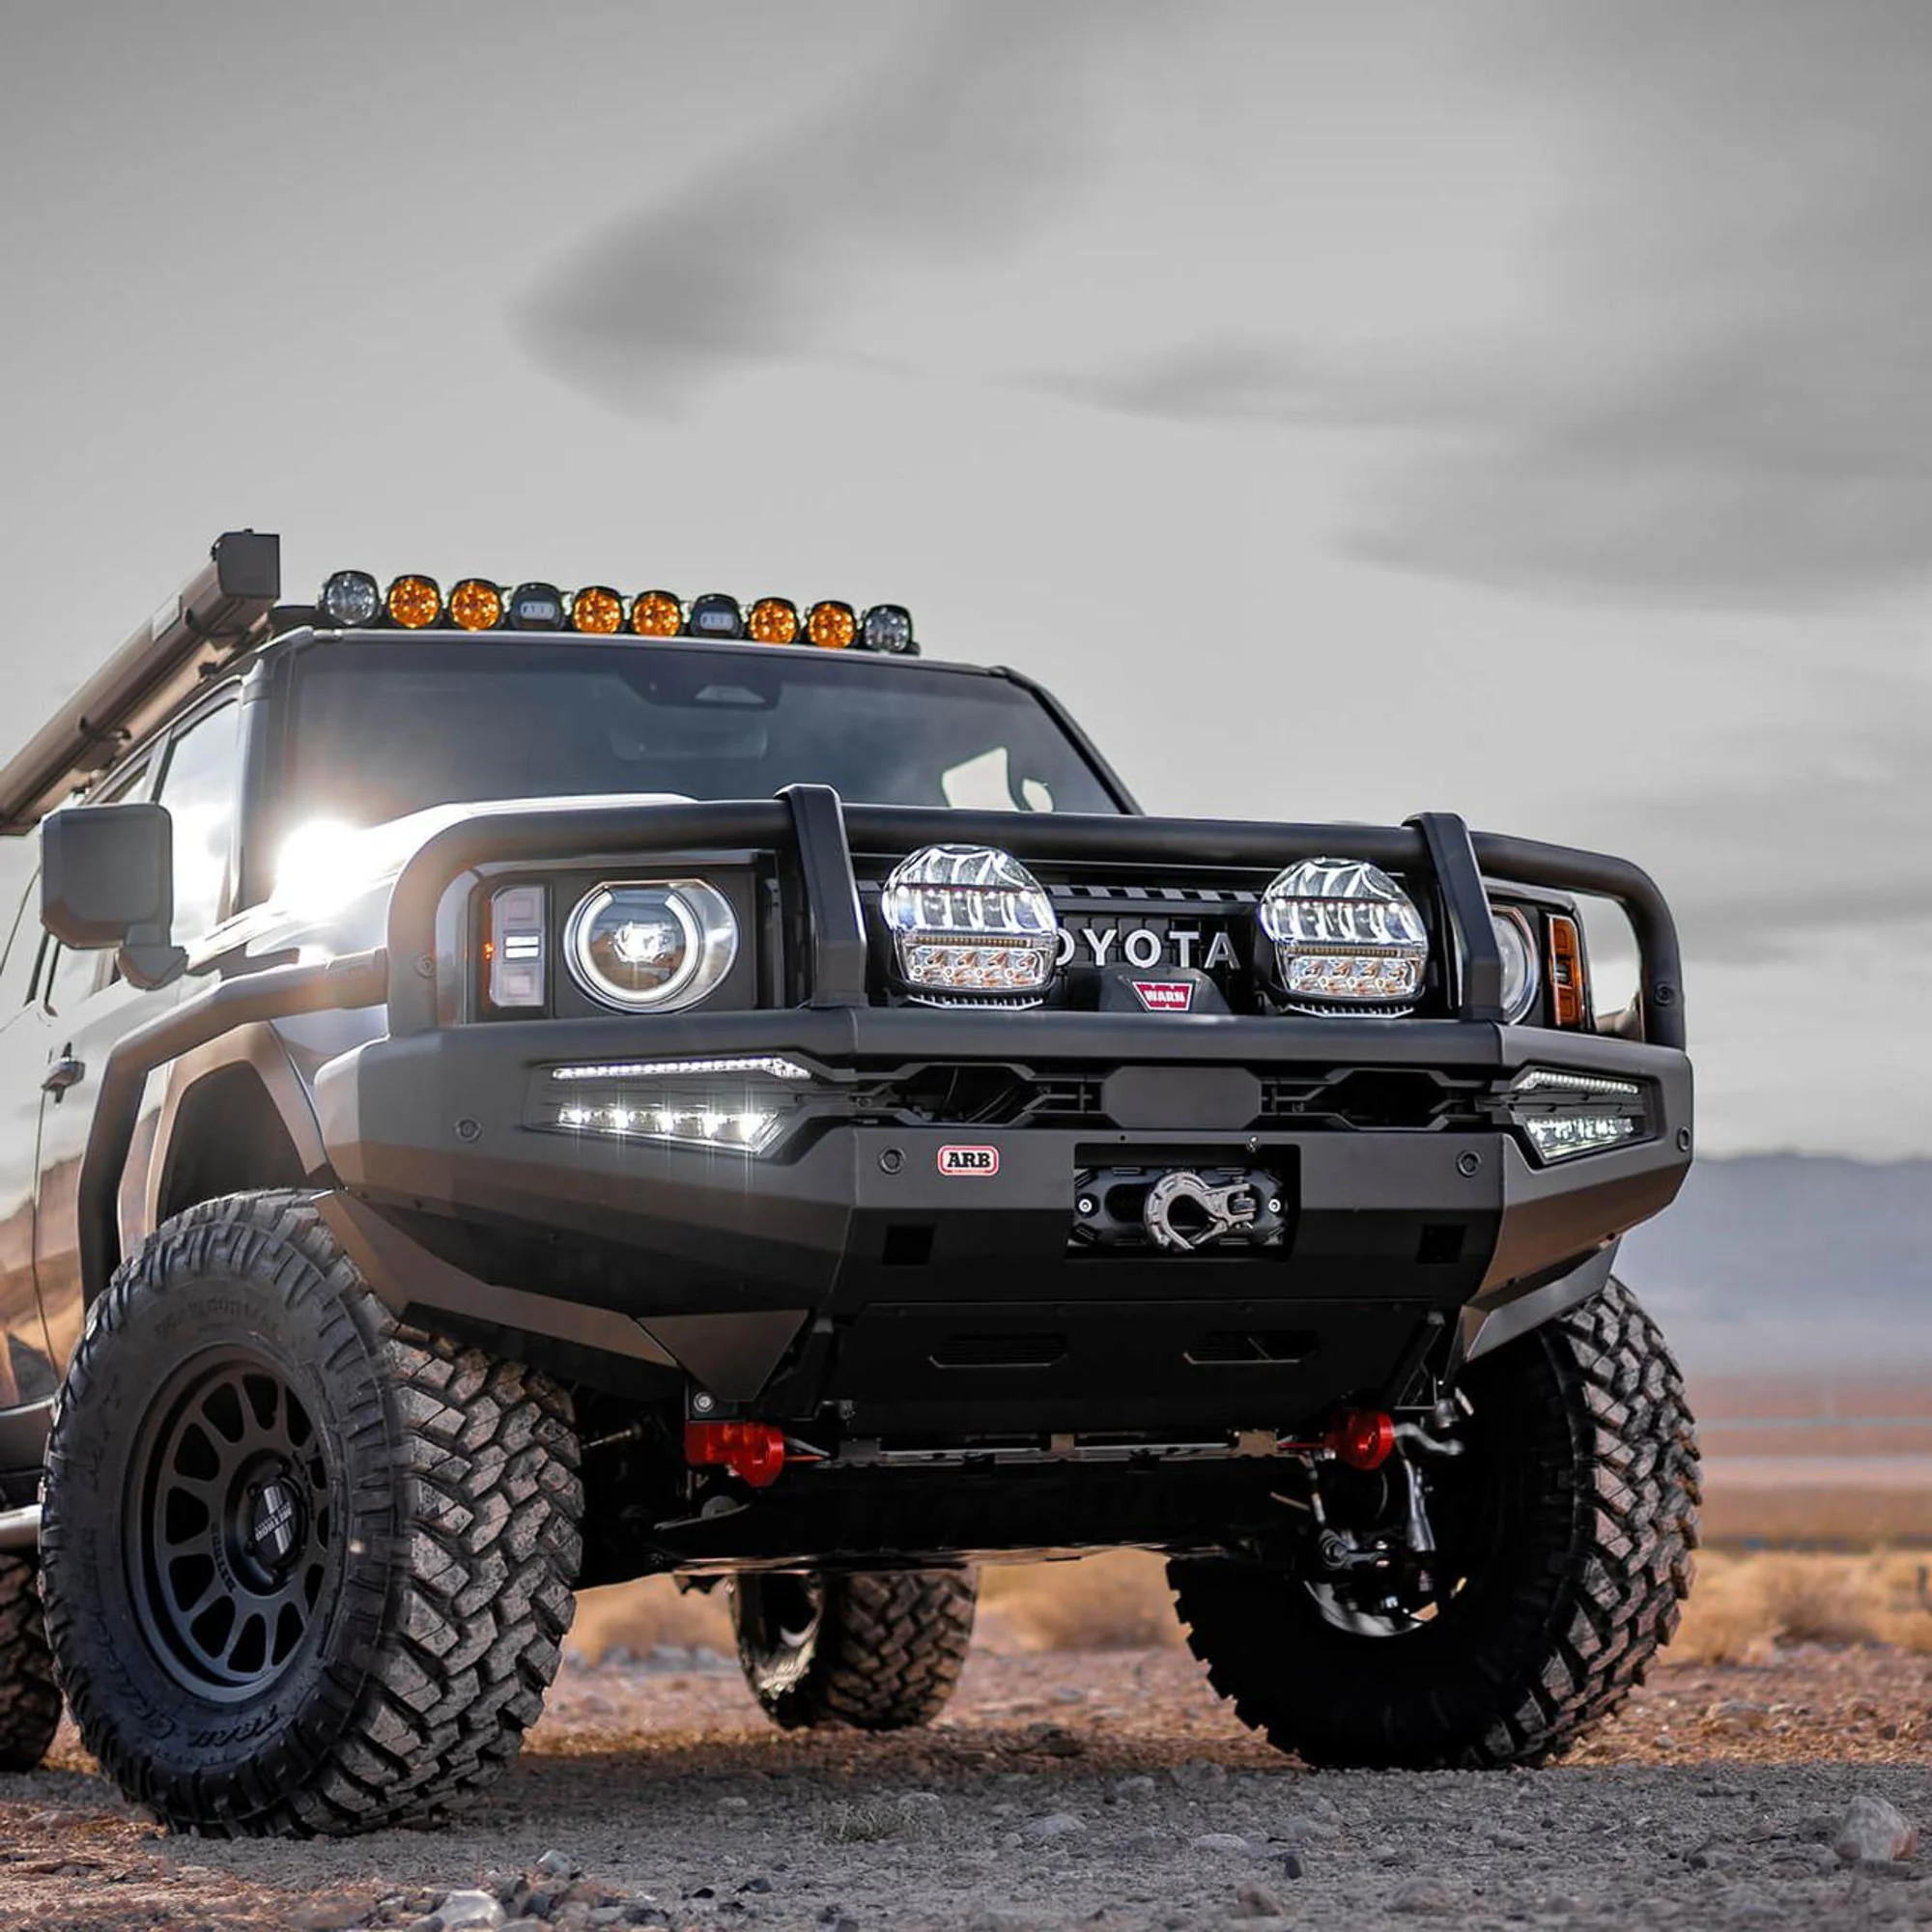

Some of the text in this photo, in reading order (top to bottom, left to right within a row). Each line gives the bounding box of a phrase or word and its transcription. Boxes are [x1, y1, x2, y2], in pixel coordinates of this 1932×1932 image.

[1056, 928, 1241, 970] OYOTA
[1144, 989, 1185, 1003] WARN
[947, 1151, 990, 1168] ARB
